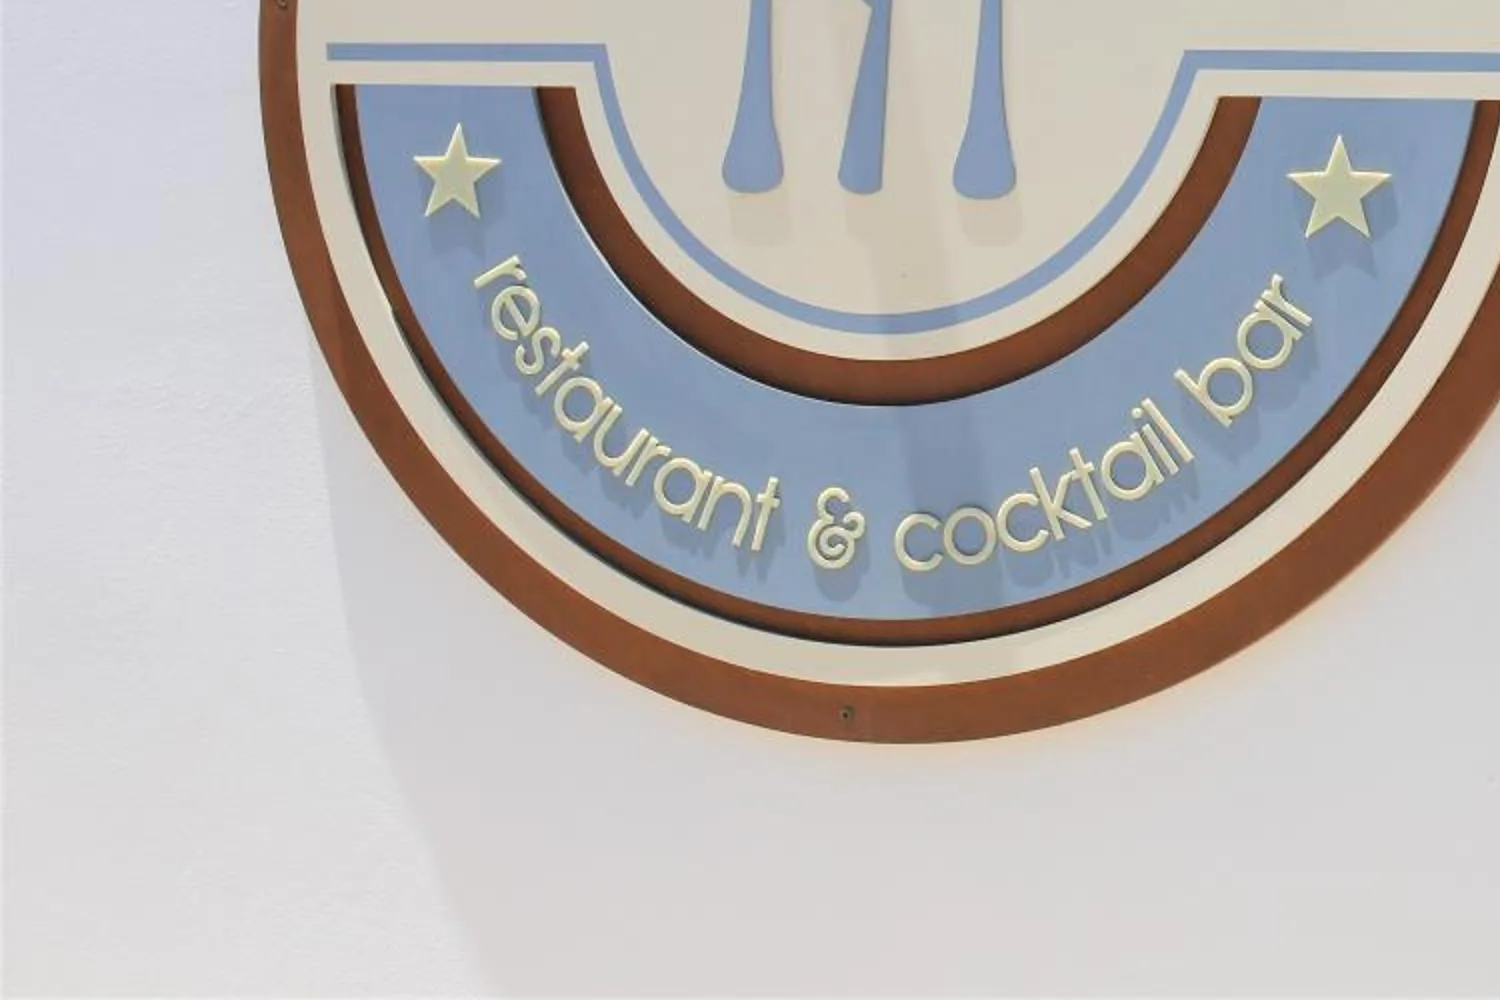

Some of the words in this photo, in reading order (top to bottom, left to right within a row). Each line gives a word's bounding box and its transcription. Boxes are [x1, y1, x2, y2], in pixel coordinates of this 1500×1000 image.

[473, 255, 781, 552] restaurant
[807, 487, 866, 570] &
[894, 397, 1194, 572] cocktail
[1174, 273, 1314, 428] bar
